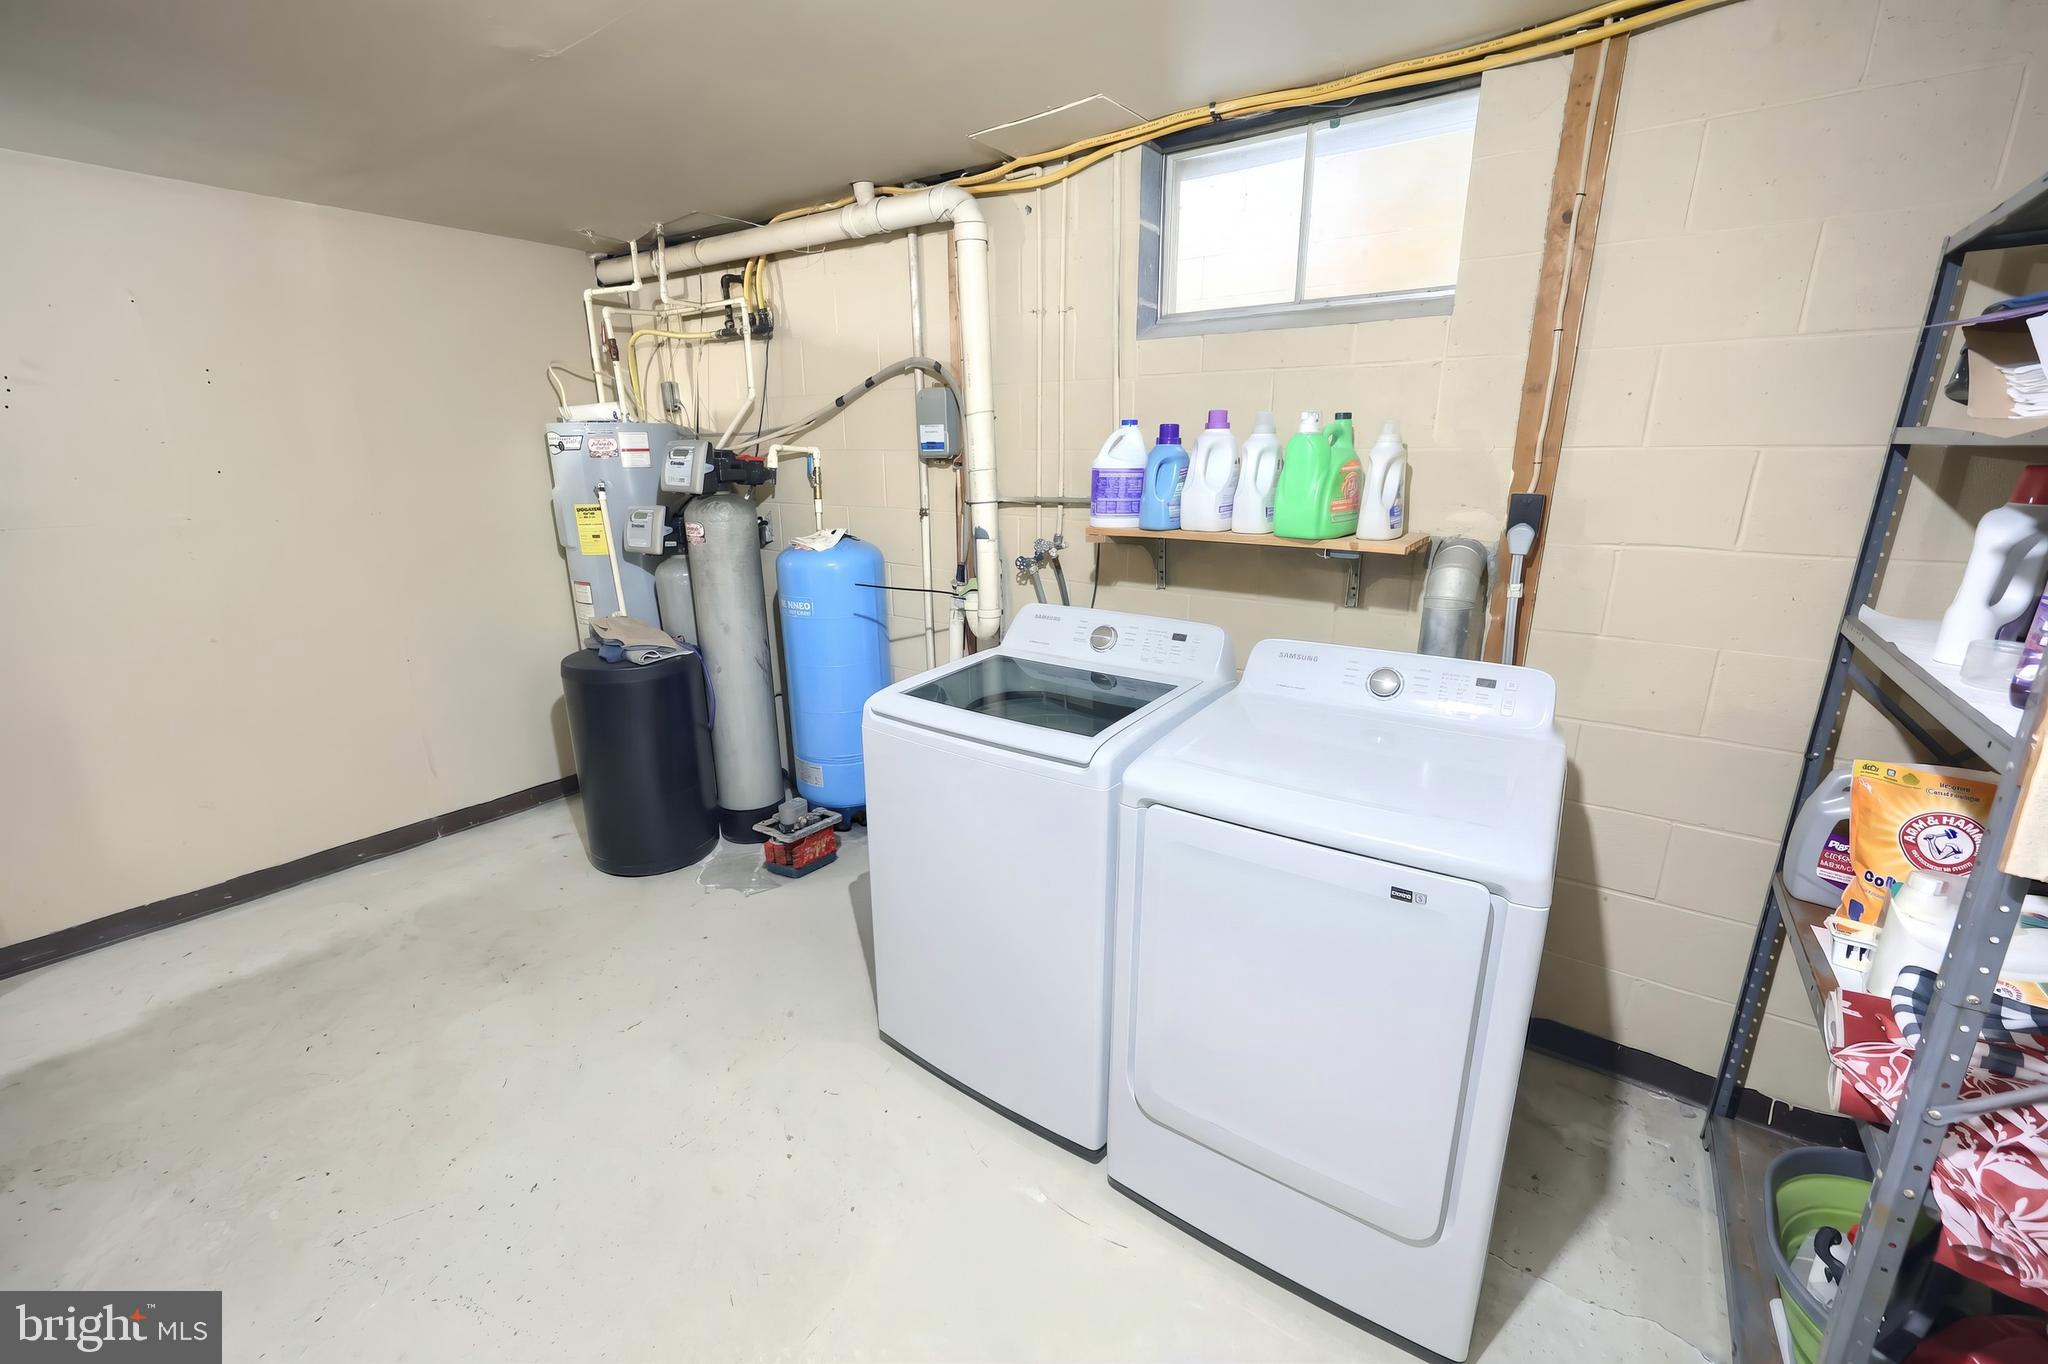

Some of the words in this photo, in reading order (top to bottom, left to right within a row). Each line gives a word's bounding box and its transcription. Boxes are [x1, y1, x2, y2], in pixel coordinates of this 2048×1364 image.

[1279, 651, 1320, 663] SAMSUNG
[1903, 819, 1929, 844] ARM
[1926, 815, 1940, 825] &
